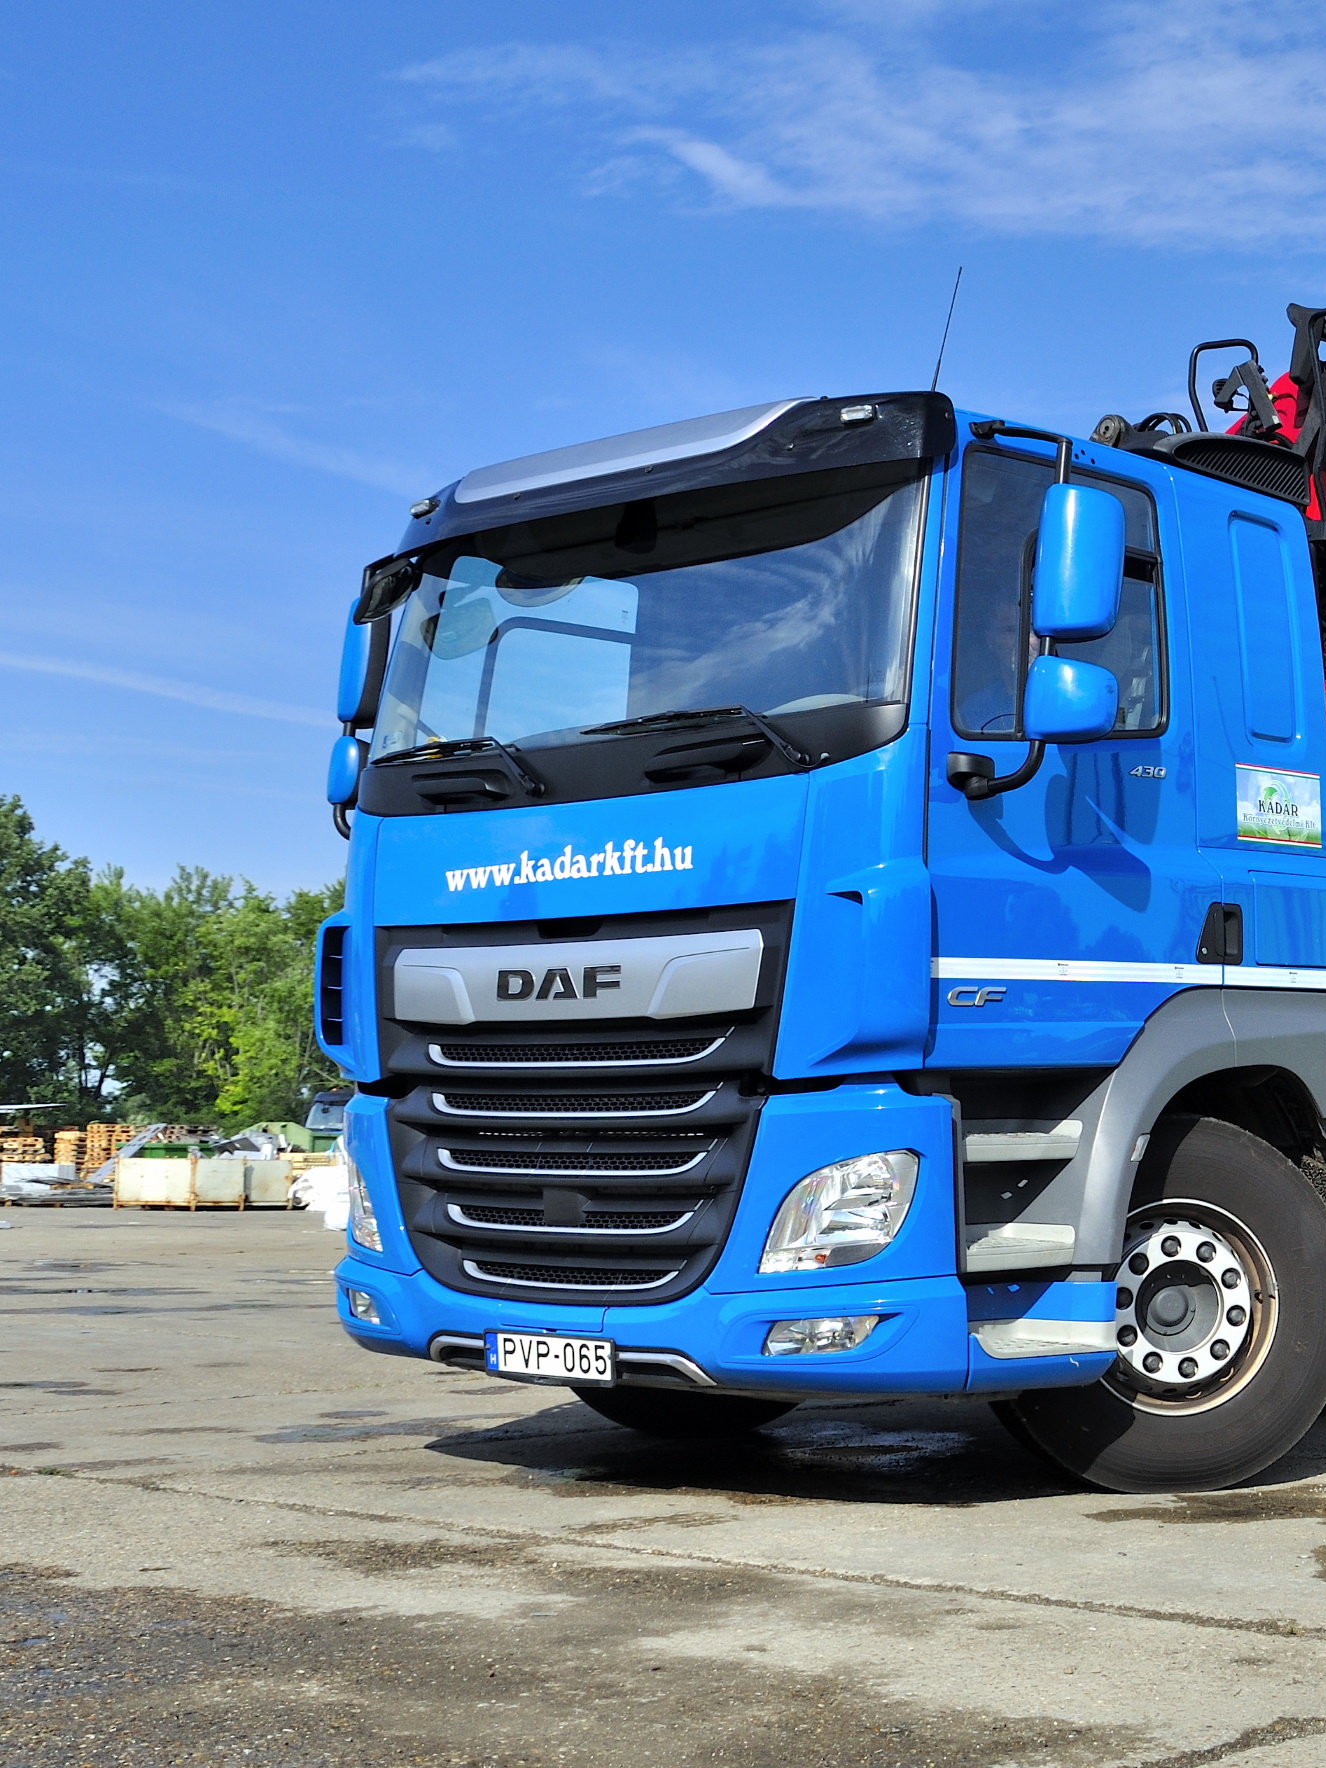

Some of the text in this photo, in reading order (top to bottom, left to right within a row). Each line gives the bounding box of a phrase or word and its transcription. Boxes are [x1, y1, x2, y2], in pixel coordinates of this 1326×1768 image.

[1129, 765, 1167, 779] 430
[1258, 797, 1299, 817] KÁDÁR
[445, 837, 694, 892] www.kadarkft.hu
[496, 964, 622, 1001] DAF
[947, 986, 1007, 1008] CF
[490, 1337, 607, 1375] H PVP-065
